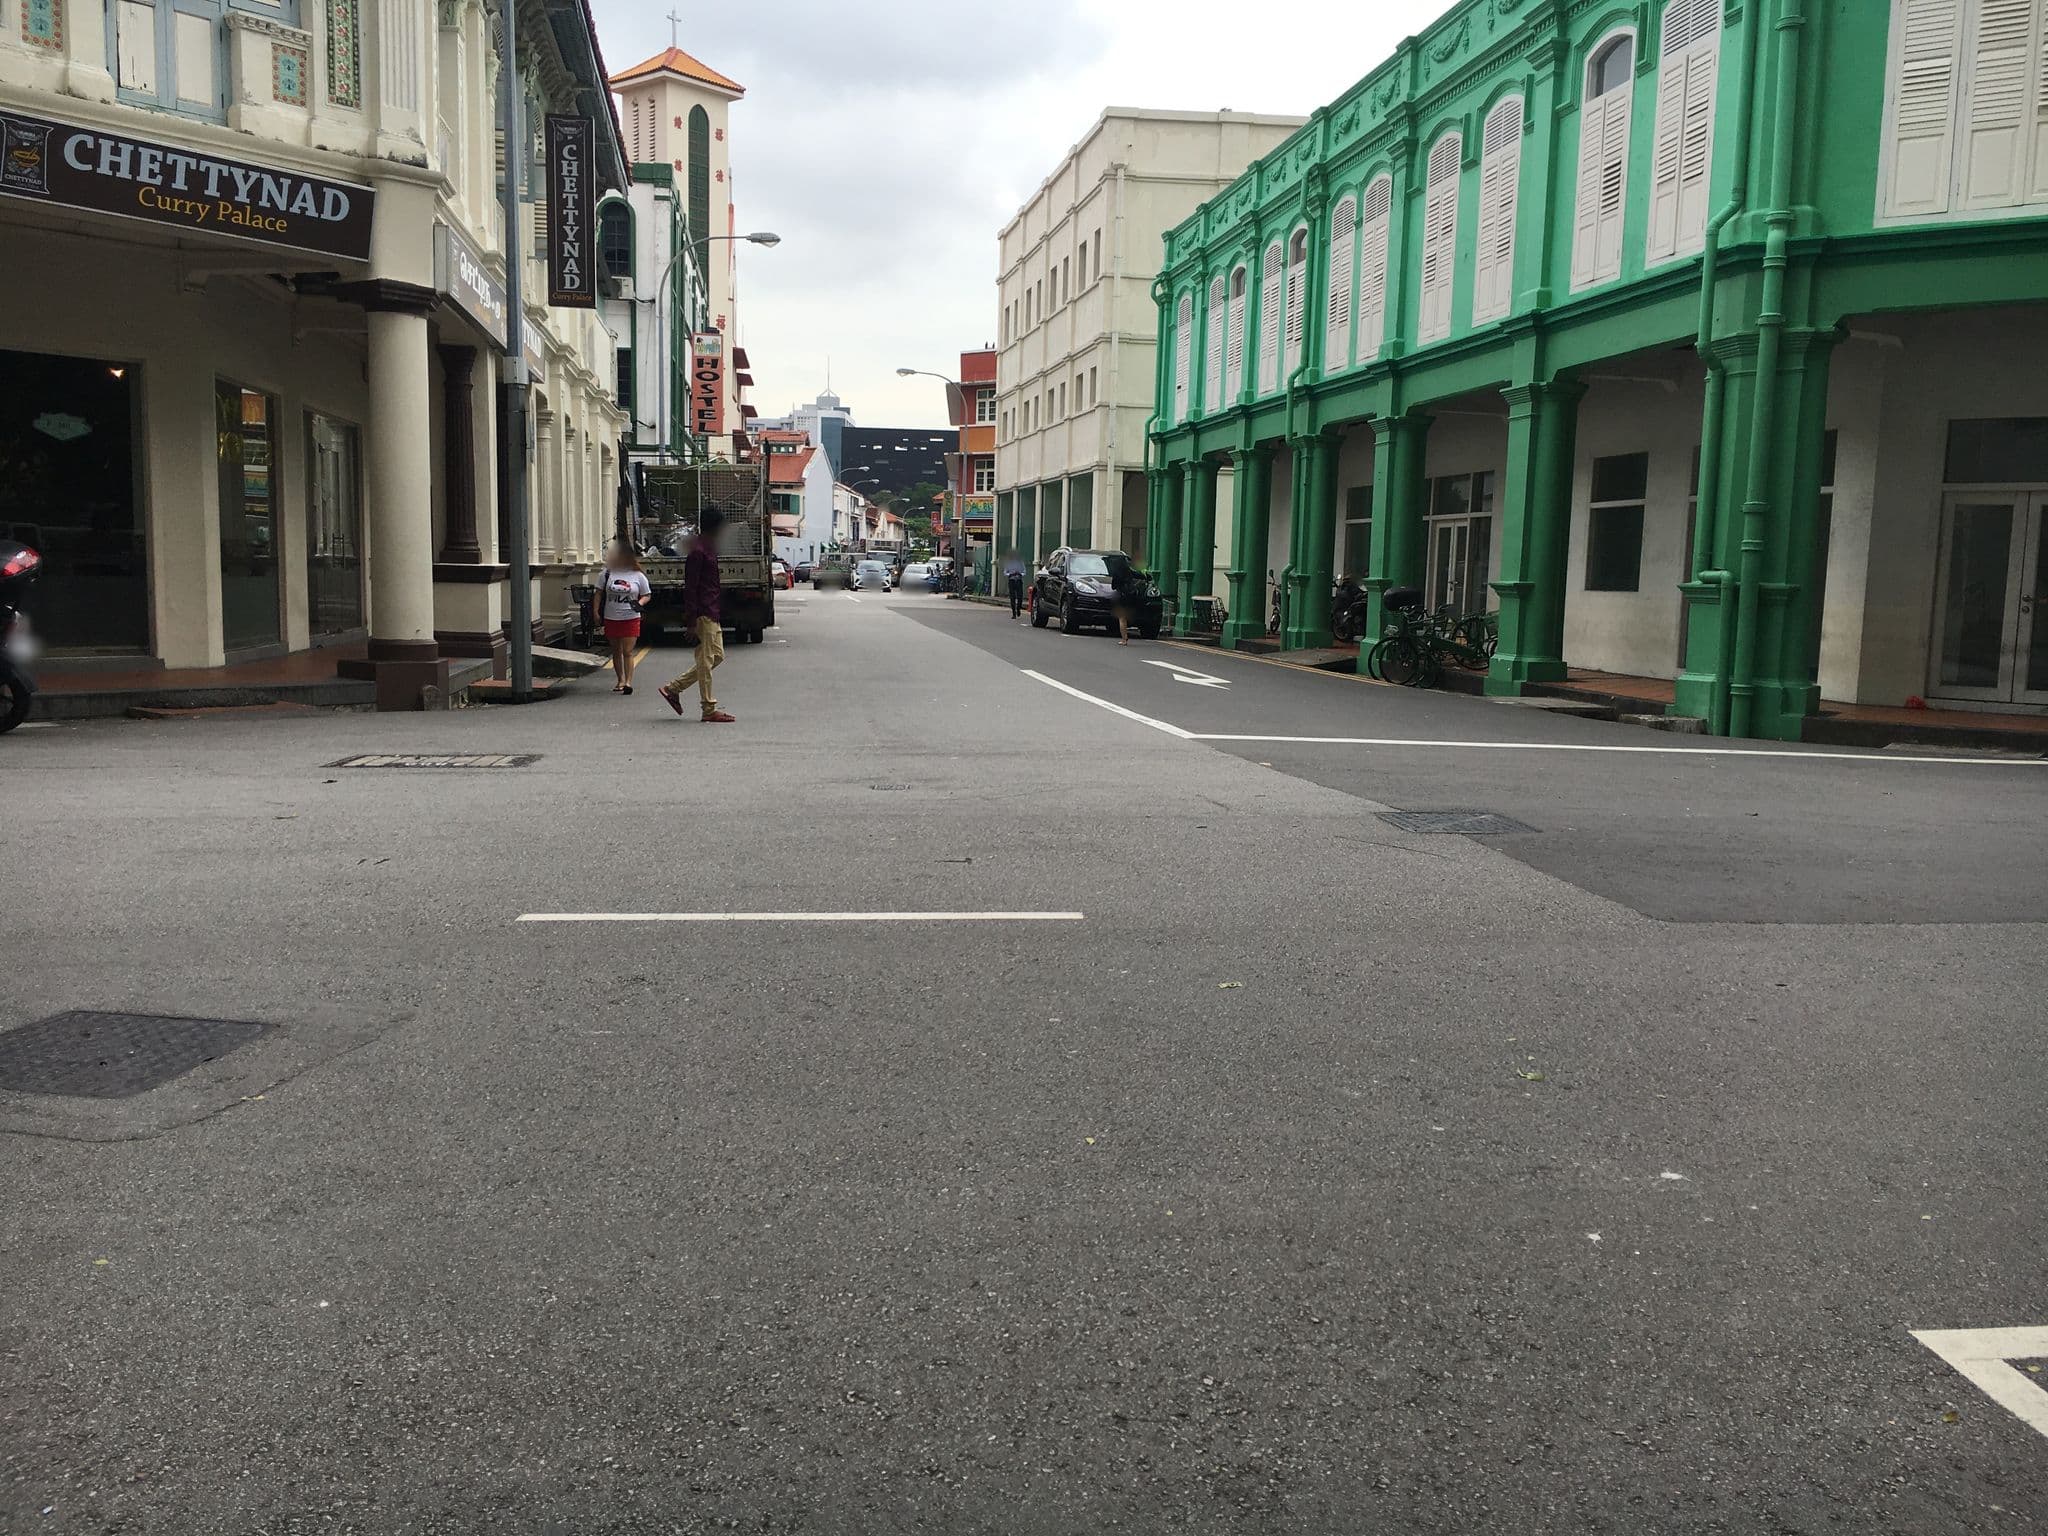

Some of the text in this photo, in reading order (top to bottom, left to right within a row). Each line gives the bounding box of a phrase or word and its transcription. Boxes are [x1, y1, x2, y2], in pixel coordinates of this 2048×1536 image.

[4, 173, 42, 185] CHETTYNAD
[64, 133, 350, 222] CHETTYNAD
[138, 186, 288, 232] Curry Palace
[560, 144, 581, 290] CHETTYNAD
[552, 292, 593, 302] Curry Palace
[695, 358, 720, 433] HOSTEL
